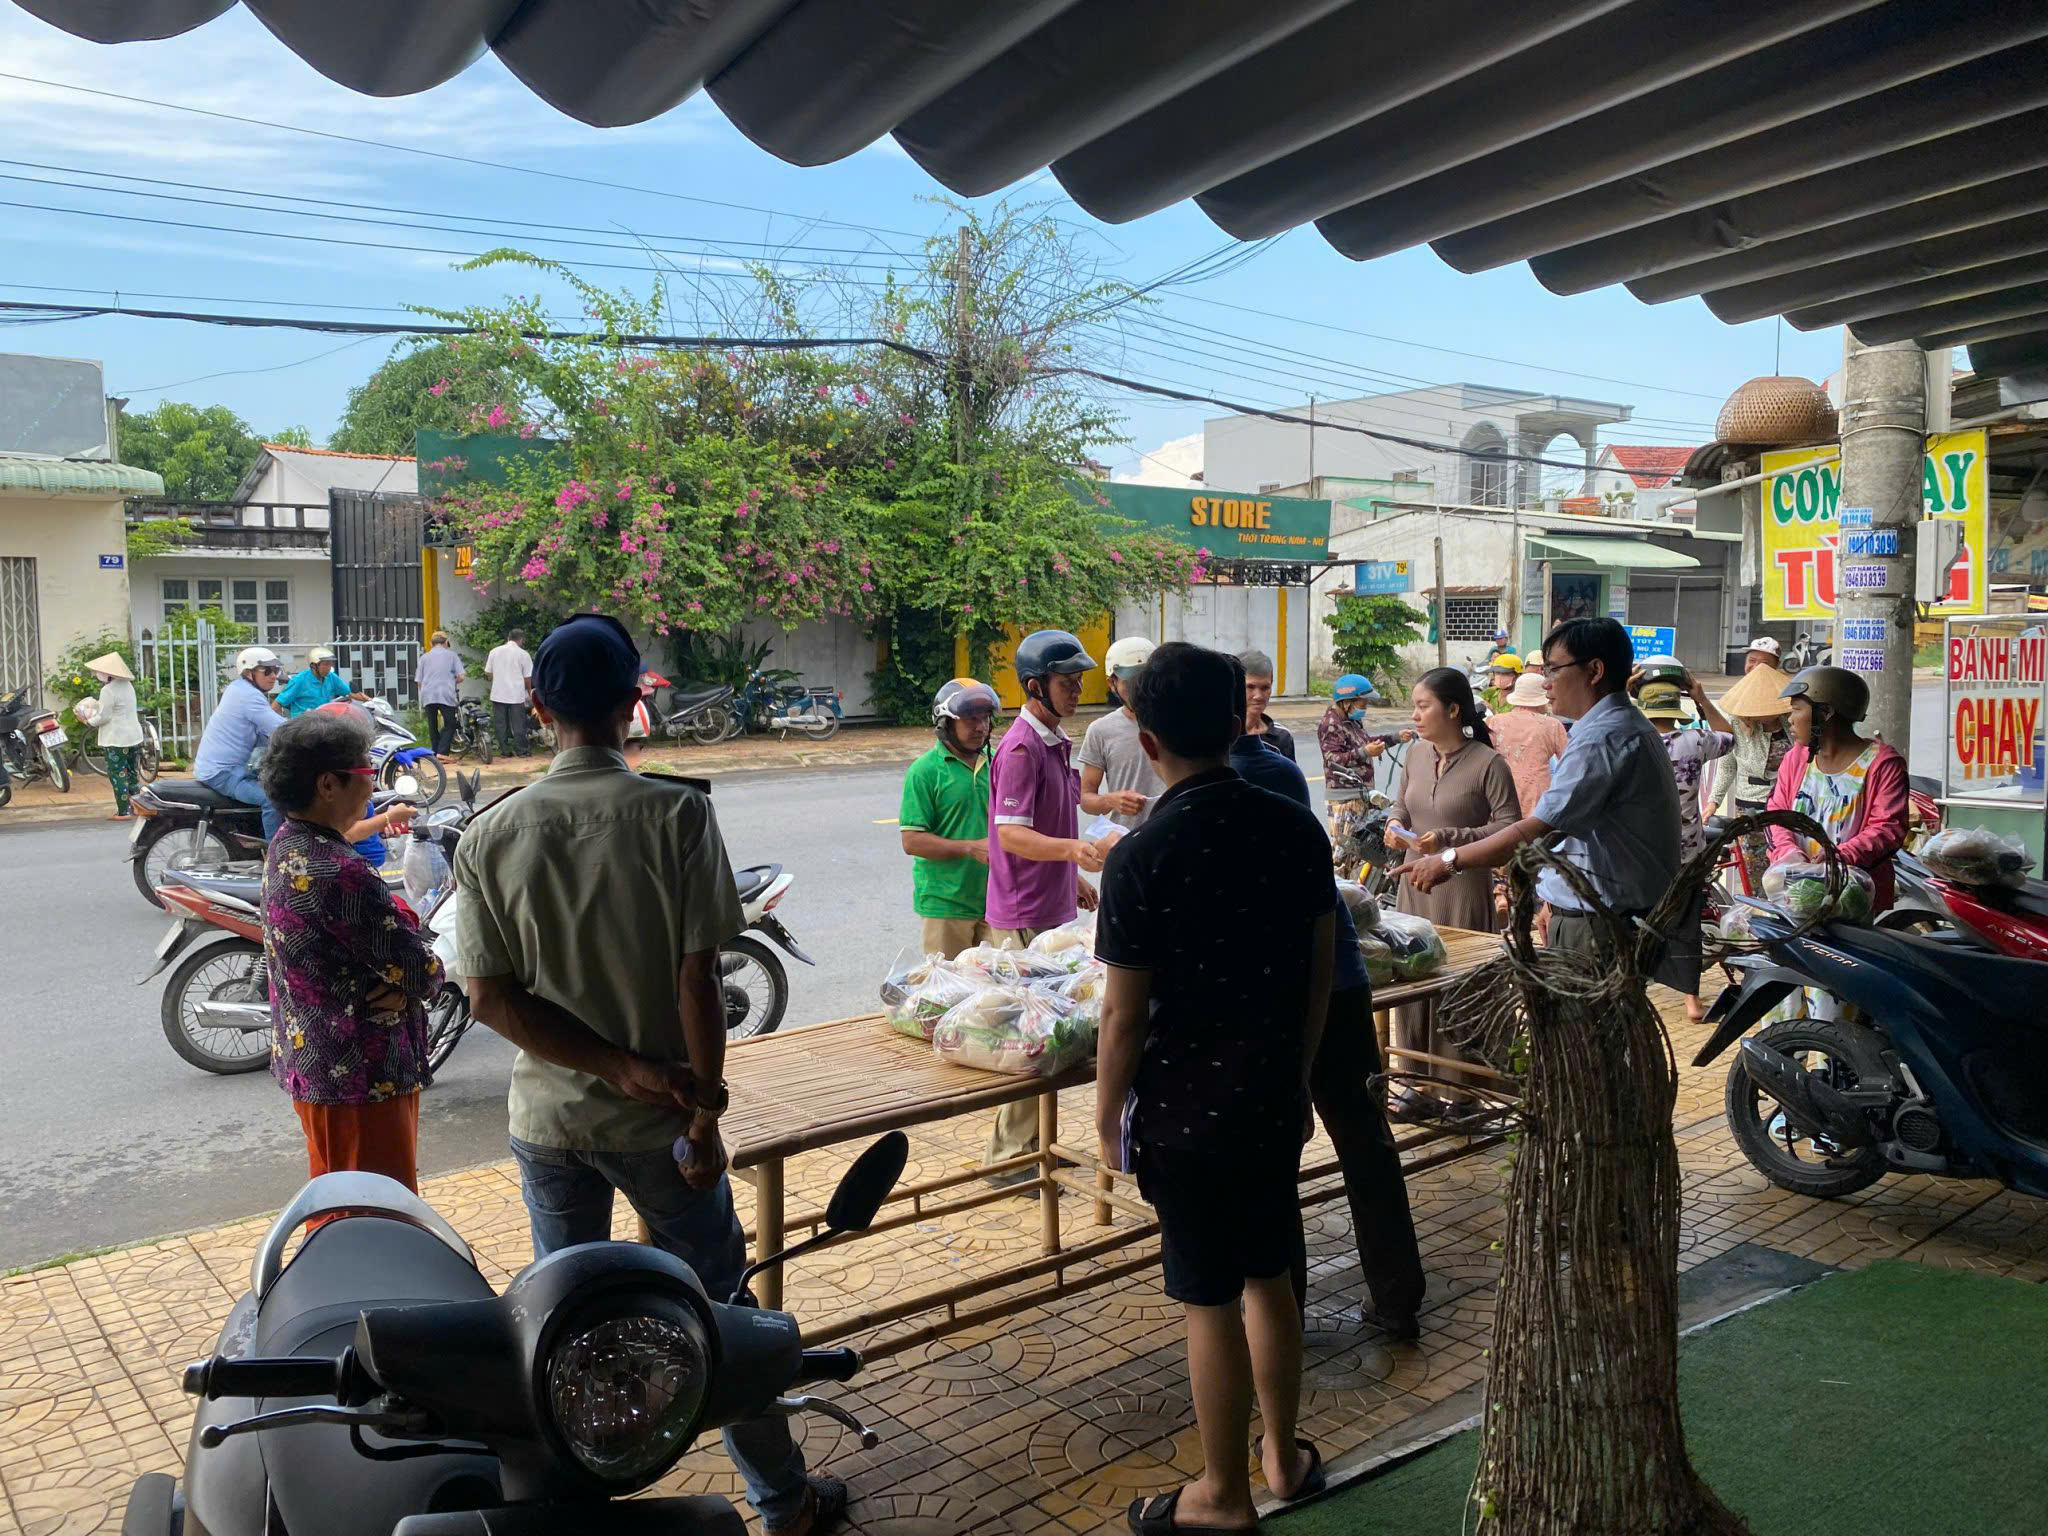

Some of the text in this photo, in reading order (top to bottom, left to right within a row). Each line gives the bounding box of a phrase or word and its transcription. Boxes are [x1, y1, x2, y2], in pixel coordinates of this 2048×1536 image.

[1191, 496, 1272, 528] STORE
[103, 556, 120, 564] 79
[1870, 656, 1883, 670] 966
[1950, 626, 2046, 682] BÁNH MÌ
[1956, 697, 2039, 766] CHAY
